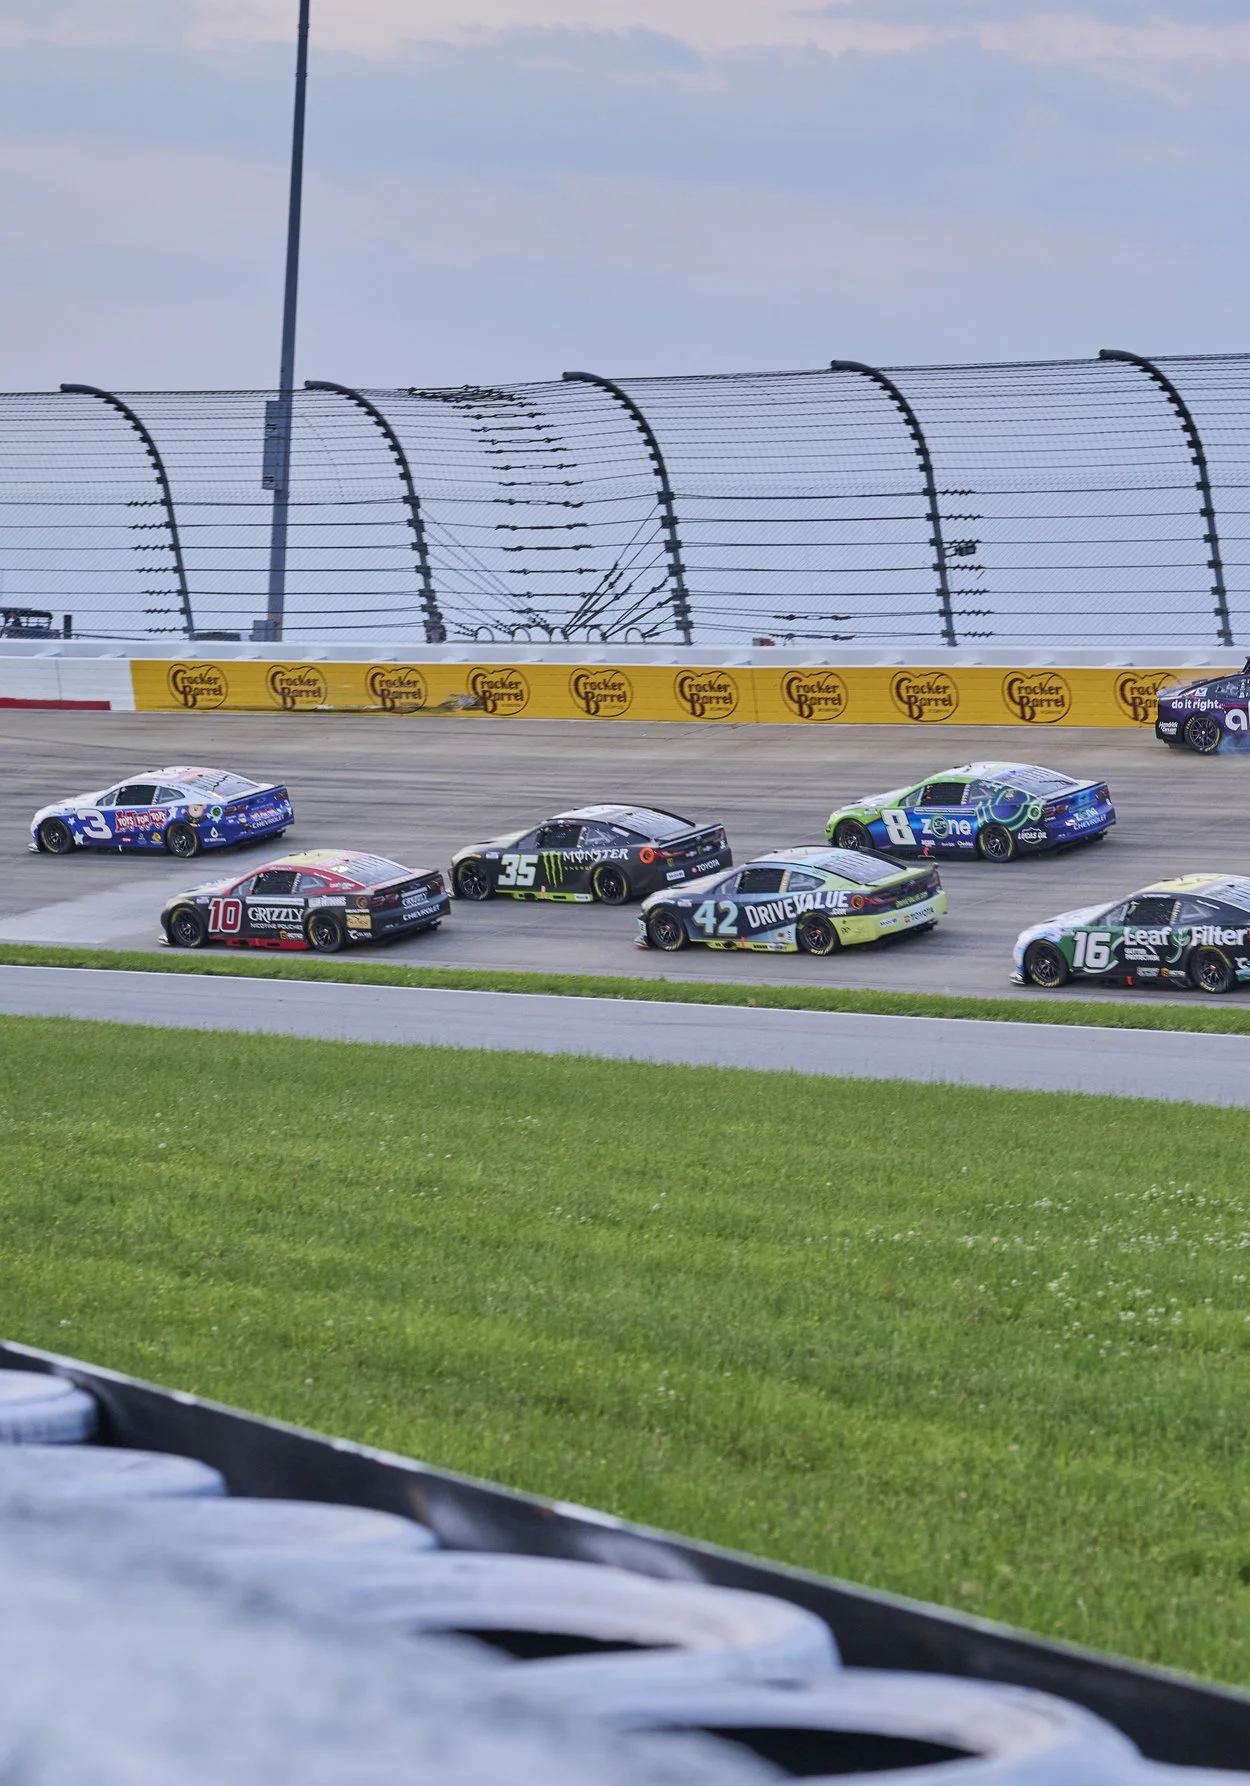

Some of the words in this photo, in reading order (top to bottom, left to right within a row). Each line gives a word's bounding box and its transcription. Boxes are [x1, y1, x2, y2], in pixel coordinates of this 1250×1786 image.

[172, 669, 220, 696] Cracker
[271, 670, 319, 696] Cracker
[370, 672, 419, 697] Cracker
[472, 673, 521, 698] Cracker
[574, 674, 625, 700] Cracker
[679, 676, 730, 701] Cracker
[786, 676, 839, 703] Cracker
[896, 677, 949, 704] Cracker
[1008, 678, 1062, 705] Cracker
[181, 684, 223, 708] Barrel
[281, 686, 322, 710] Barrel
[381, 688, 422, 712] Barrel
[482, 689, 524, 713] Barrel
[584, 691, 627, 715] Barrel
[689, 692, 733, 717] Barrel
[797, 694, 841, 718] Barrel
[907, 694, 952, 720] Barrel
[1019, 696, 1065, 721] Barrel
[1171, 699, 1184, 709] do
[1184, 698, 1192, 709] it
[76, 808, 113, 839] 3
[881, 808, 917, 846] 8
[1018, 831, 1037, 840] LUCAS
[497, 853, 539, 887] 35
[696, 858, 720, 873] TOYOTA
[208, 897, 242, 933] 10
[247, 907, 304, 923] GRIZZLY
[692, 900, 739, 936] 42
[744, 890, 851, 929] DRIVEVALUE
[1124, 926, 1173, 946] Leaf
[1190, 925, 1249, 946] Filter
[1072, 931, 1112, 969] 16
